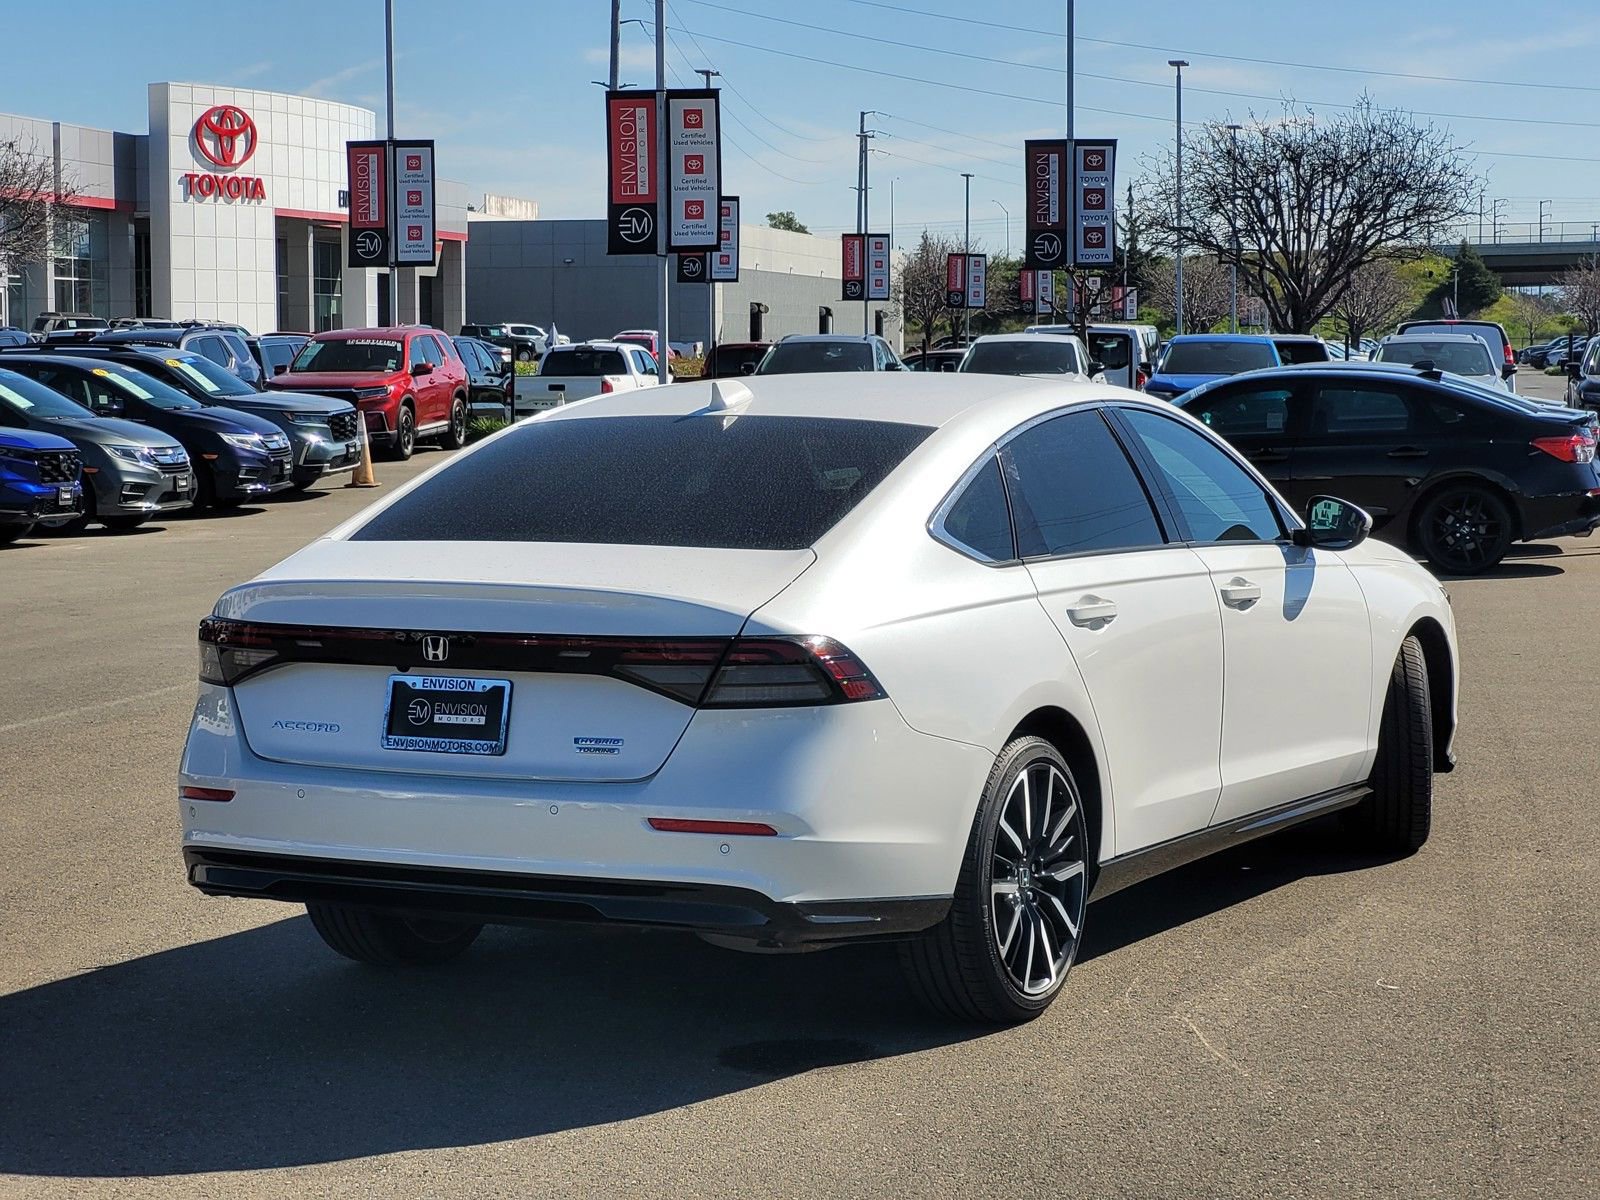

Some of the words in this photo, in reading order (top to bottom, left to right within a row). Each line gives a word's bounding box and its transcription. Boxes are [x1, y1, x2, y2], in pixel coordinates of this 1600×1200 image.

[620, 107, 636, 195] ENVISION
[638, 115, 646, 188] MOTORS
[185, 173, 266, 200] TOYOTA
[357, 153, 369, 222] ENVISION
[1036, 153, 1049, 223] ENVISION
[422, 678, 476, 690] ENVISION
[434, 702, 488, 716] ENVISION
[271, 720, 340, 733] ACCORD
[386, 737, 498, 753] ENVISIONMOTORS.COM
[576, 737, 622, 746] HYBRID
[576, 747, 619, 755] TOURING
